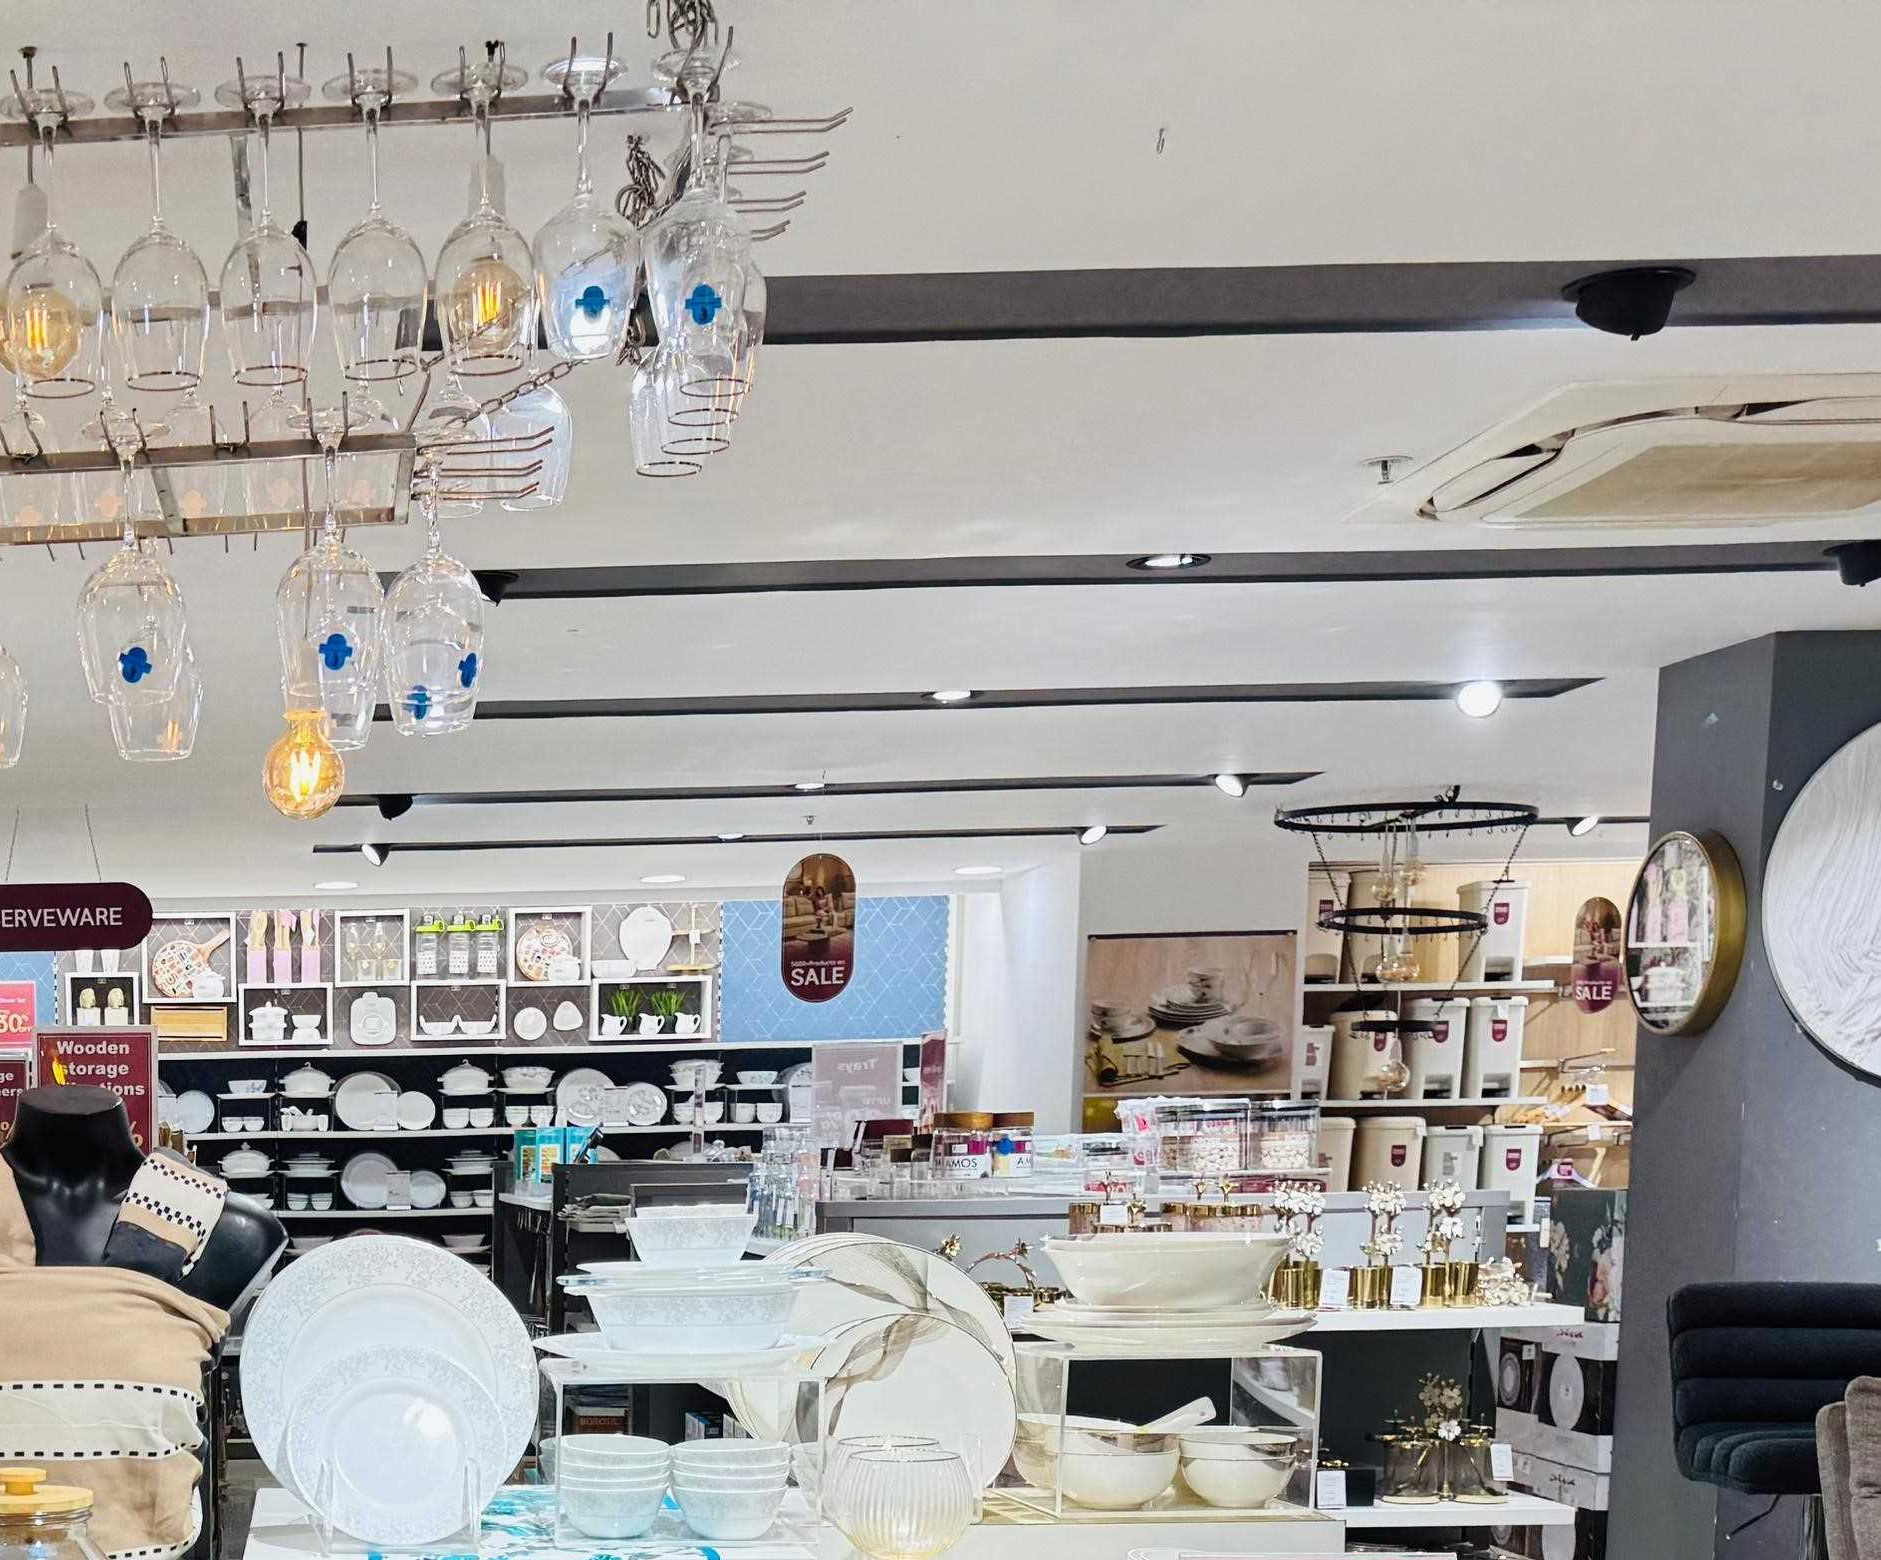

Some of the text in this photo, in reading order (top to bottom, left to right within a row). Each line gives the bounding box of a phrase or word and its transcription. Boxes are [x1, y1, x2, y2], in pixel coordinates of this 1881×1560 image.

[791, 966, 845, 987] SALE
[1575, 985, 1612, 1000] SALE
[57, 1040, 130, 1055] Wooden
